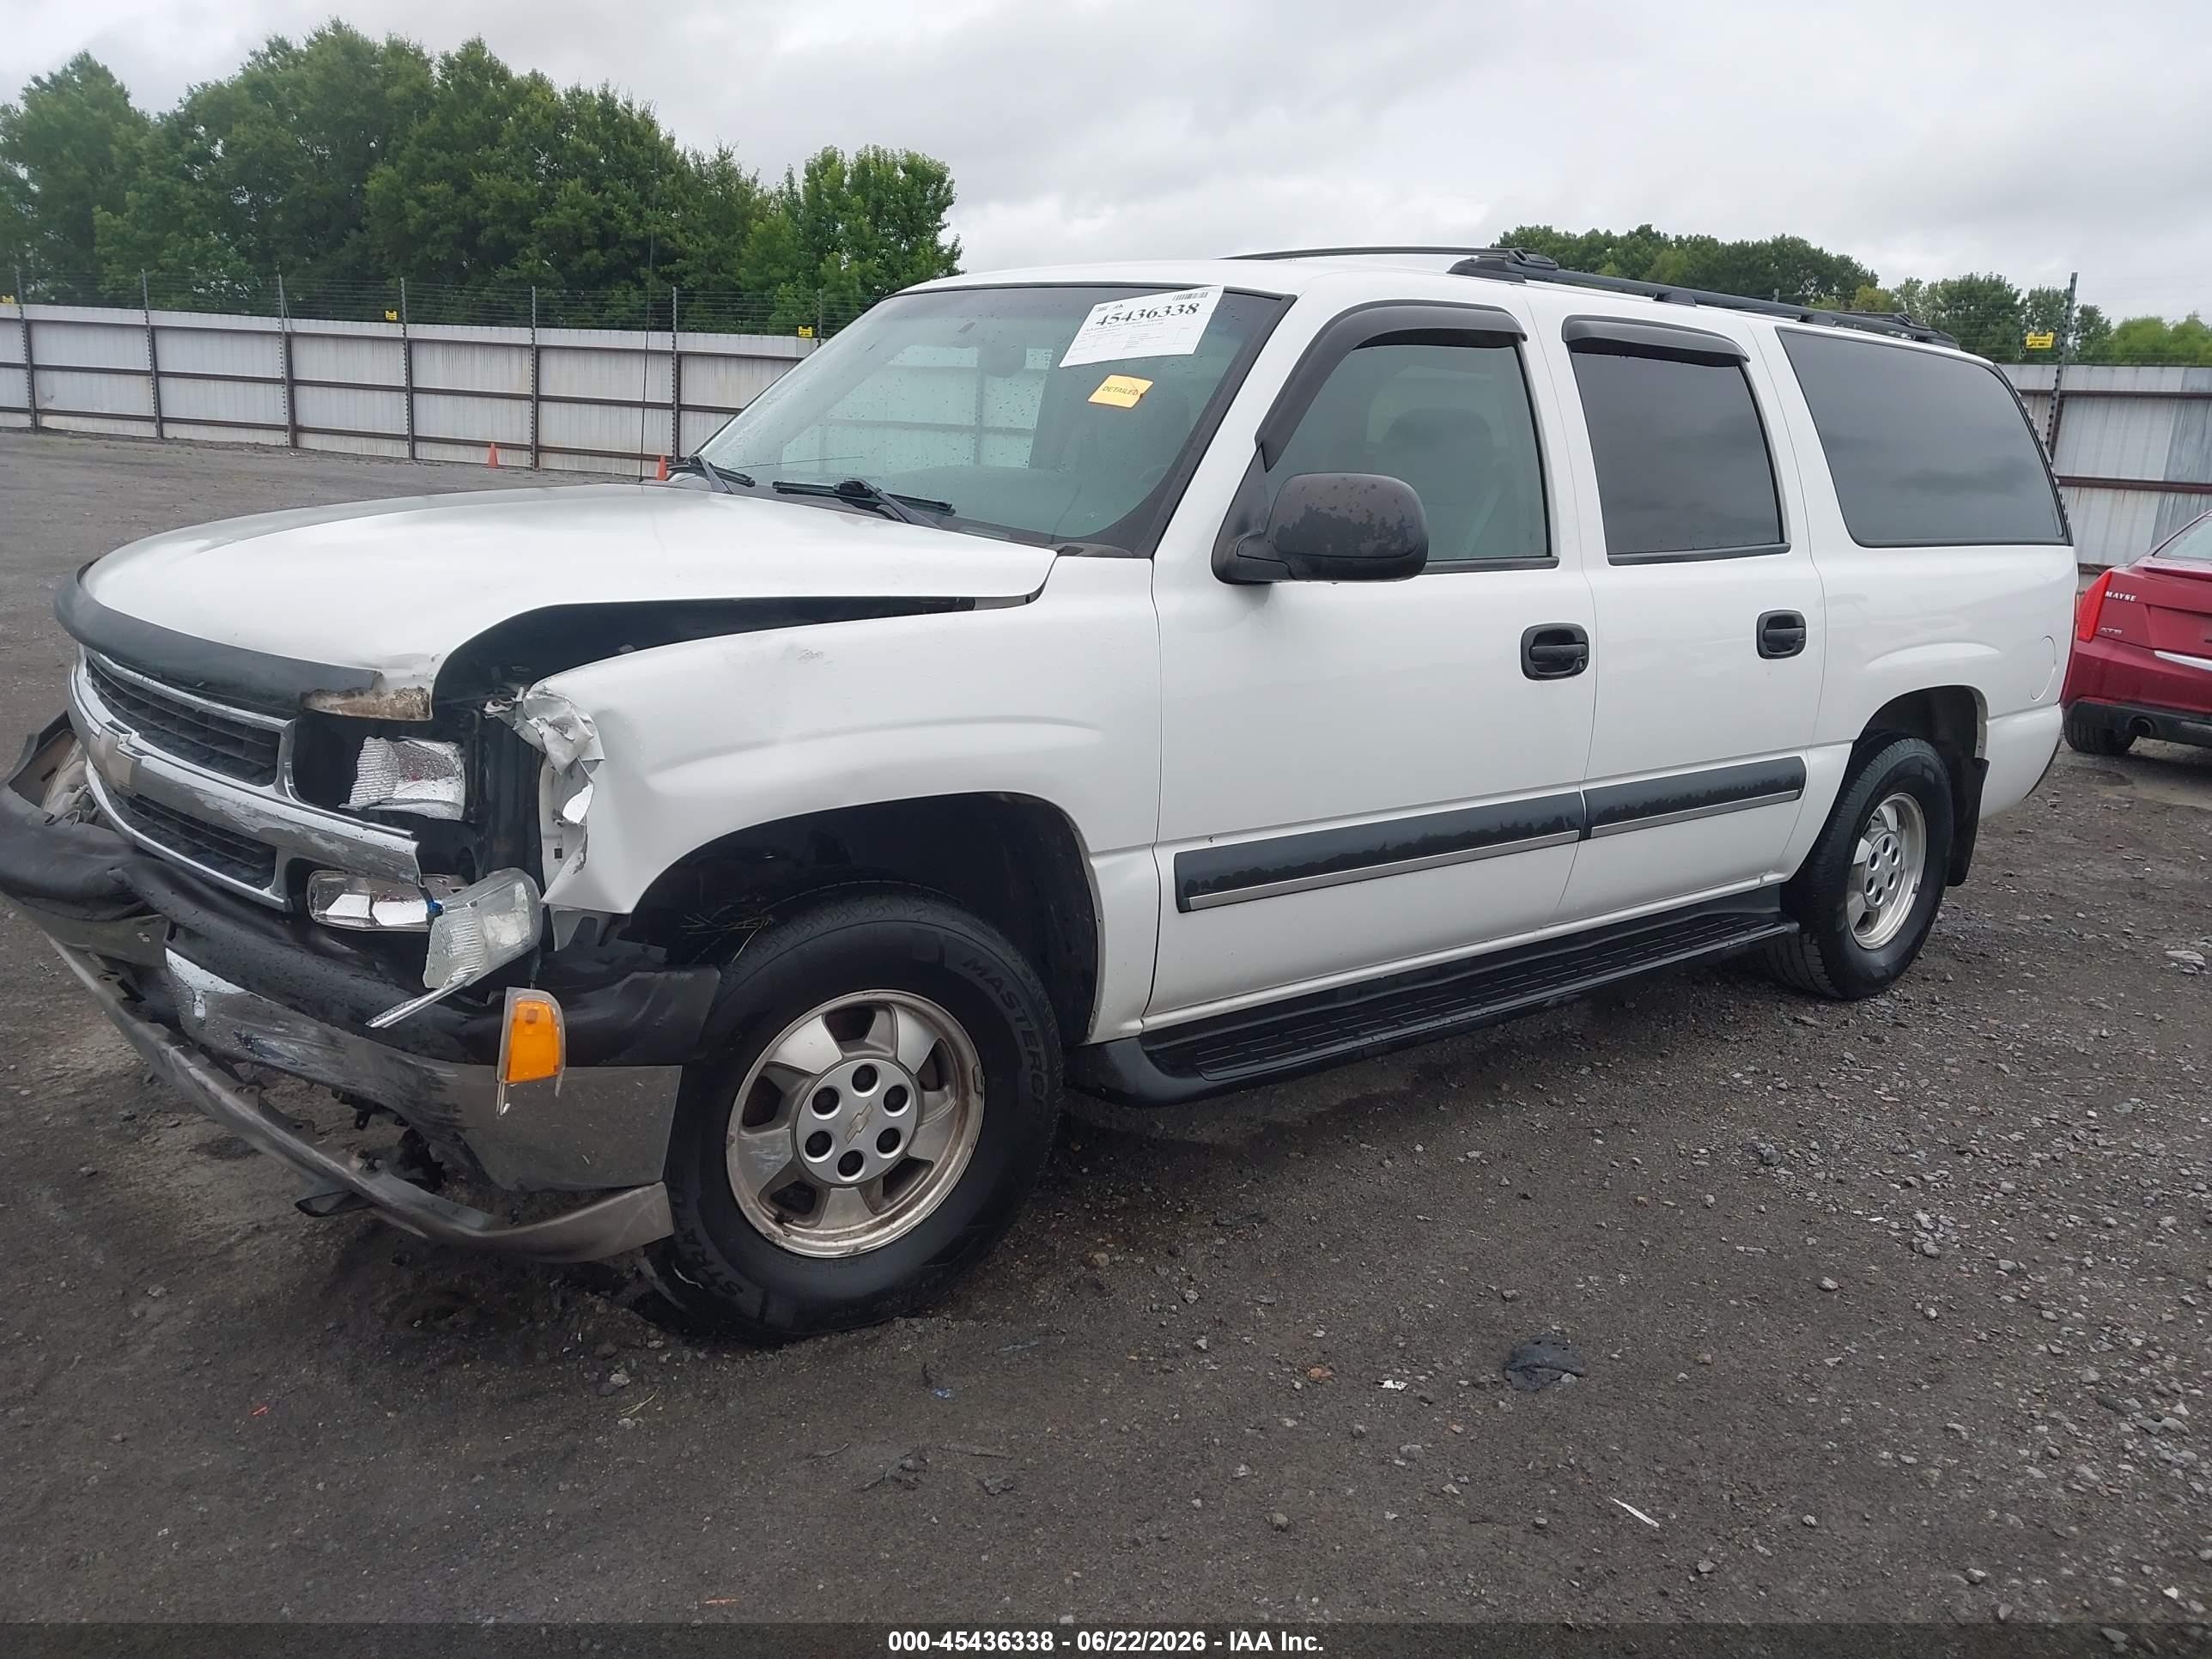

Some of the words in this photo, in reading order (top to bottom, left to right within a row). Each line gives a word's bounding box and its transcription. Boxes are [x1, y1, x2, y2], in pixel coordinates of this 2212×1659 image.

[1096, 303, 1199, 325] 45436338
[1103, 386, 1139, 395] DETAILED
[2105, 591, 2136, 601] MAYSE
